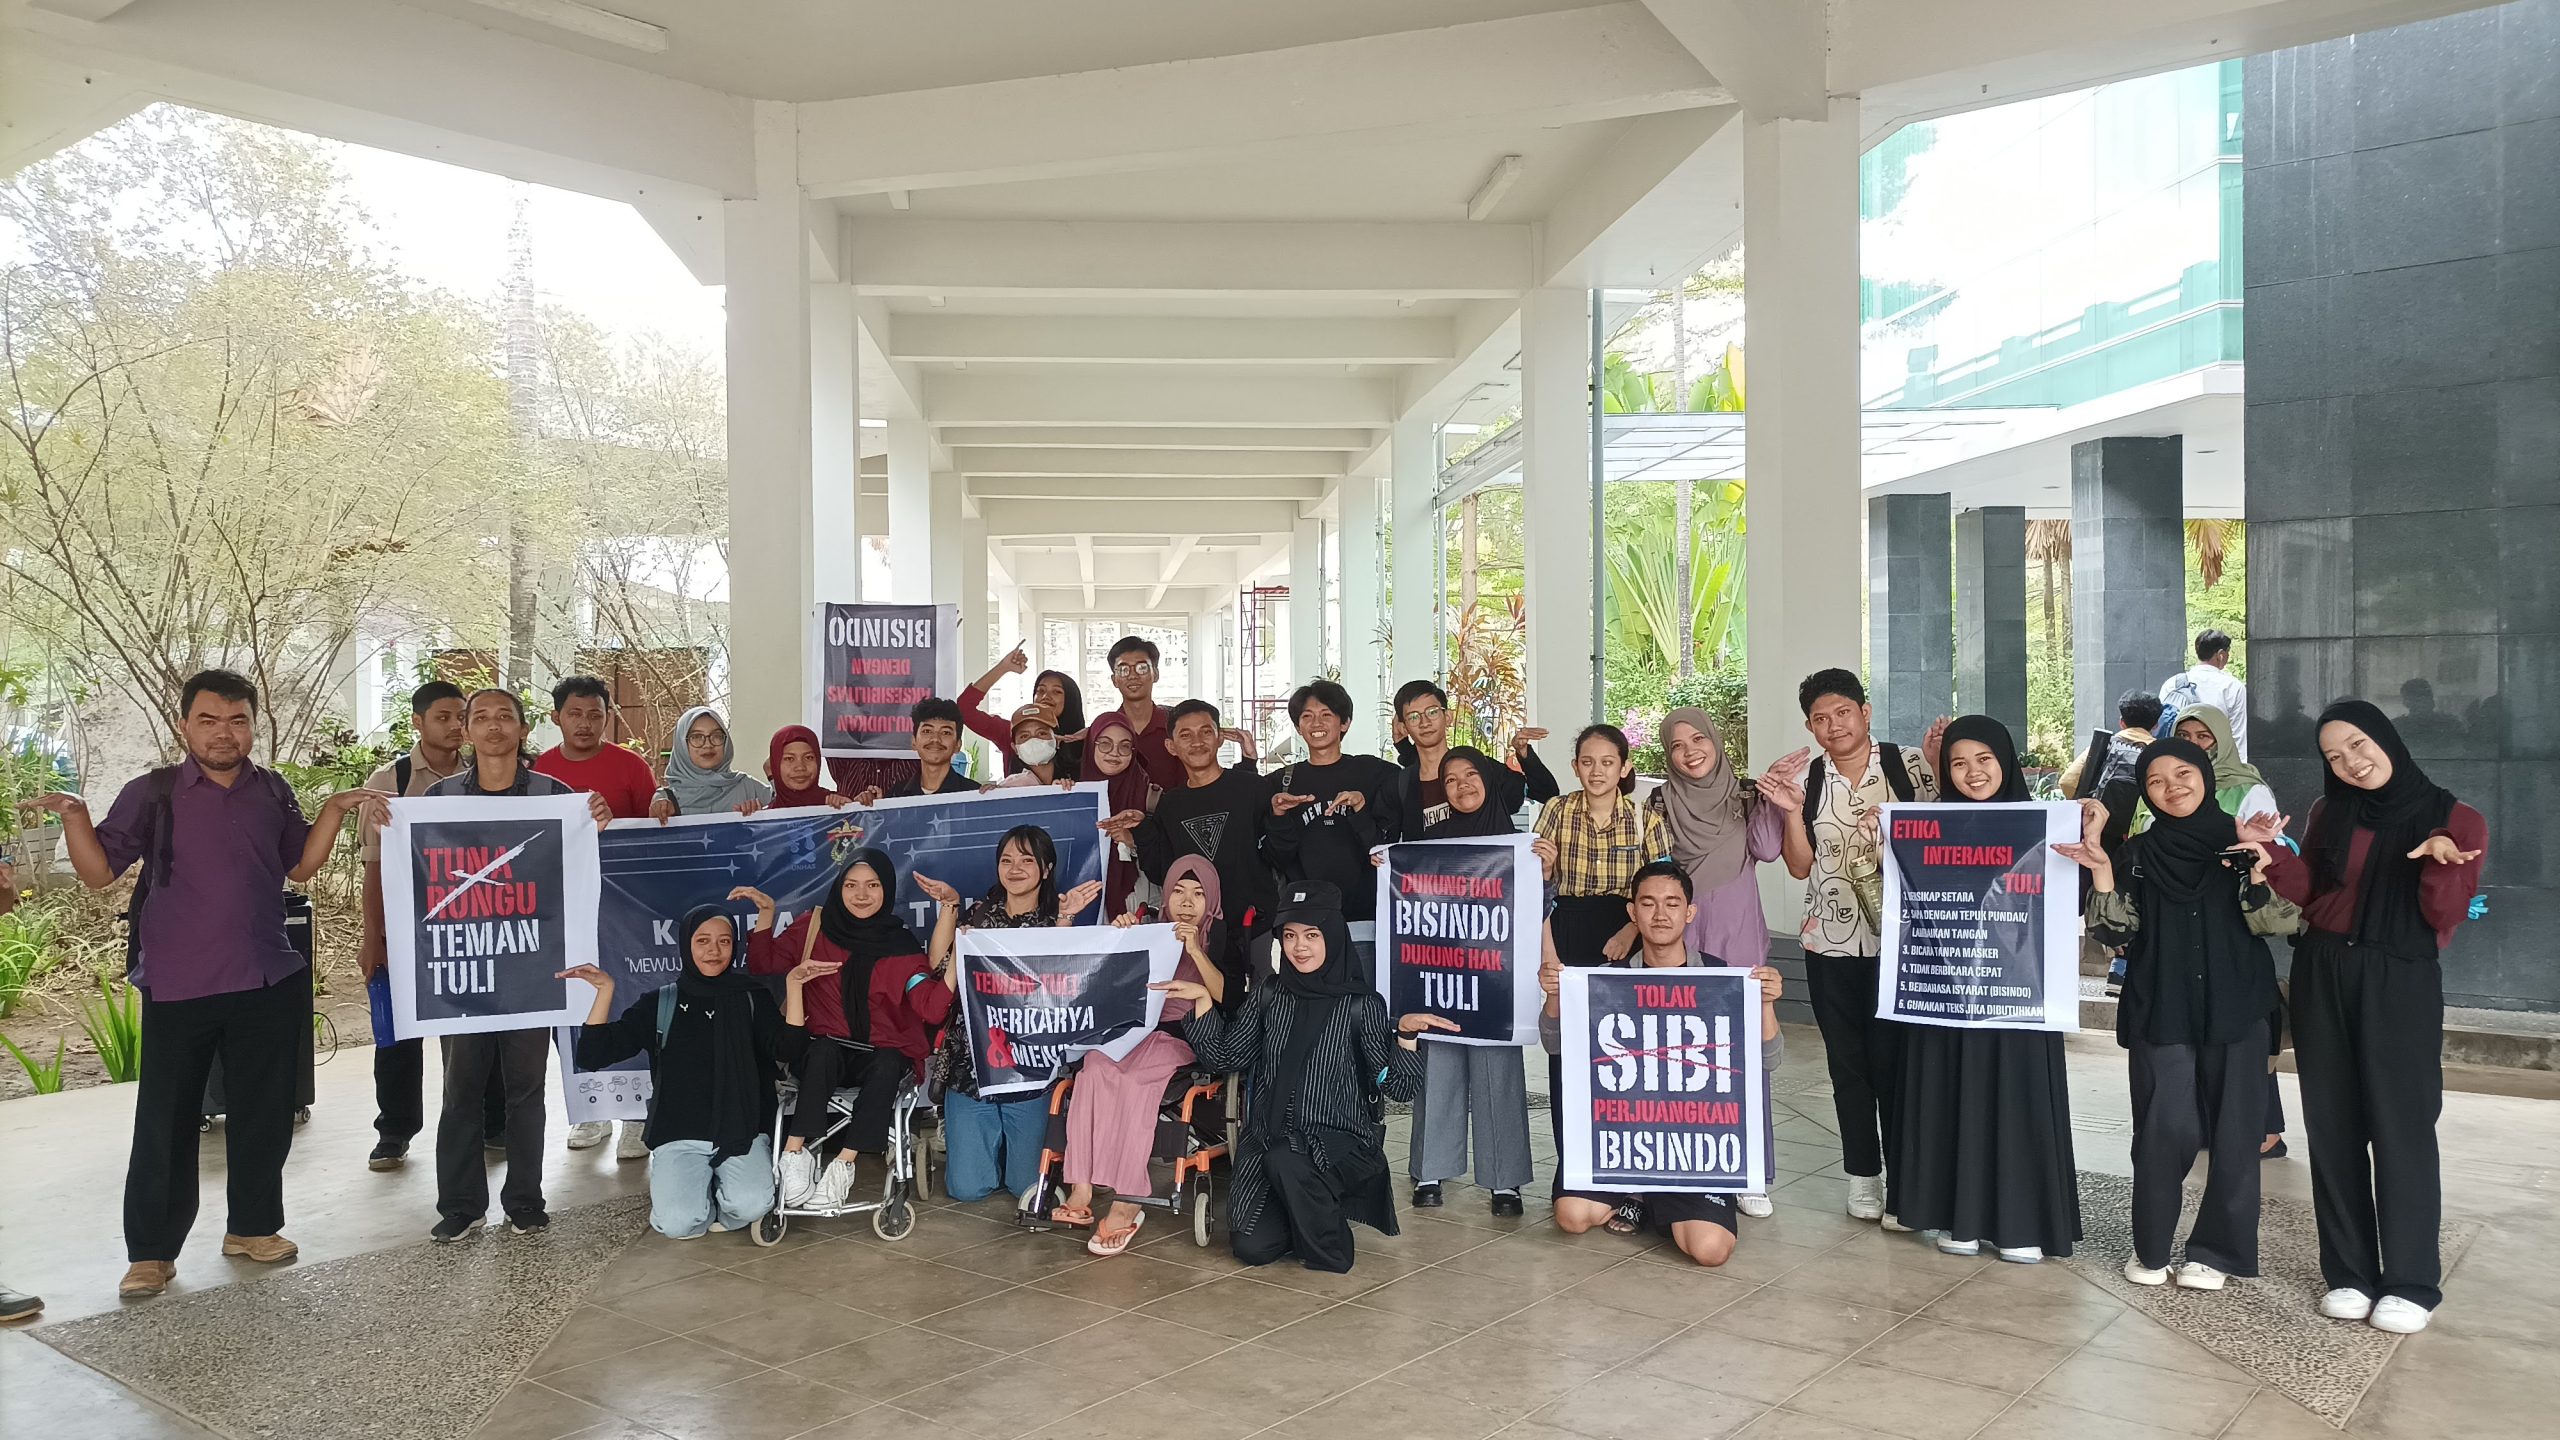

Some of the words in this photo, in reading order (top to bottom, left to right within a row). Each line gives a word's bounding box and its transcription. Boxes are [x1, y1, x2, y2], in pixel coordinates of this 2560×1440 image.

[829, 617, 931, 648] BISINDO
[852, 658, 911, 675] DENGAN
[1302, 801, 1322, 826] NEW
[1893, 820, 1941, 839] ETIKA
[423, 845, 512, 883] TUNA
[1923, 846, 2013, 865] INTERAKSI
[1401, 873, 1467, 896] DUKUNG
[1469, 876, 1503, 899] HAK
[1941, 891, 1974, 902] SETARA
[2003, 873, 2043, 895] TULI
[426, 881, 537, 920] RUNGU
[1396, 900, 1509, 942] BISINDO
[1902, 909, 1909, 919] 2.
[1924, 910, 1958, 920] DENGAN
[1959, 910, 1987, 921] TEPUK
[426, 919, 540, 957] TEMAN
[1951, 928, 1988, 940] TANGAN
[1401, 943, 1465, 968] DUKUNG
[1468, 948, 1503, 971] HAK
[1902, 945, 1909, 955] 3.
[1911, 945, 1934, 956] BICARA
[1934, 947, 1961, 957] TANPA
[1962, 947, 1999, 959] MASKER
[427, 959, 495, 996] TULI
[1901, 963, 1908, 973] 4.
[1909, 963, 1930, 974] TIDAK
[1930, 964, 1974, 977] BERBICARA
[1975, 966, 2002, 978] CEPAT
[1419, 971, 1479, 1011] TULI
[1633, 984, 1697, 1008] TOLAK
[1900, 981, 1907, 991] 5.
[1952, 984, 1988, 996] ISYARAT
[1990, 985, 2031, 999] (BISINDO)
[986, 1005, 1095, 1034] BERKARYA
[1946, 1003, 1964, 1014] TEKS
[1965, 1003, 1985, 1015] JIKA
[1986, 1004, 2043, 1017] DIBUTUHKAN
[987, 1026, 1017, 1069] &
[1597, 1013, 1732, 1093] SIBI
[1594, 1098, 1739, 1124] PERJUANGKAN
[1599, 1130, 1741, 1173] BISINDO
